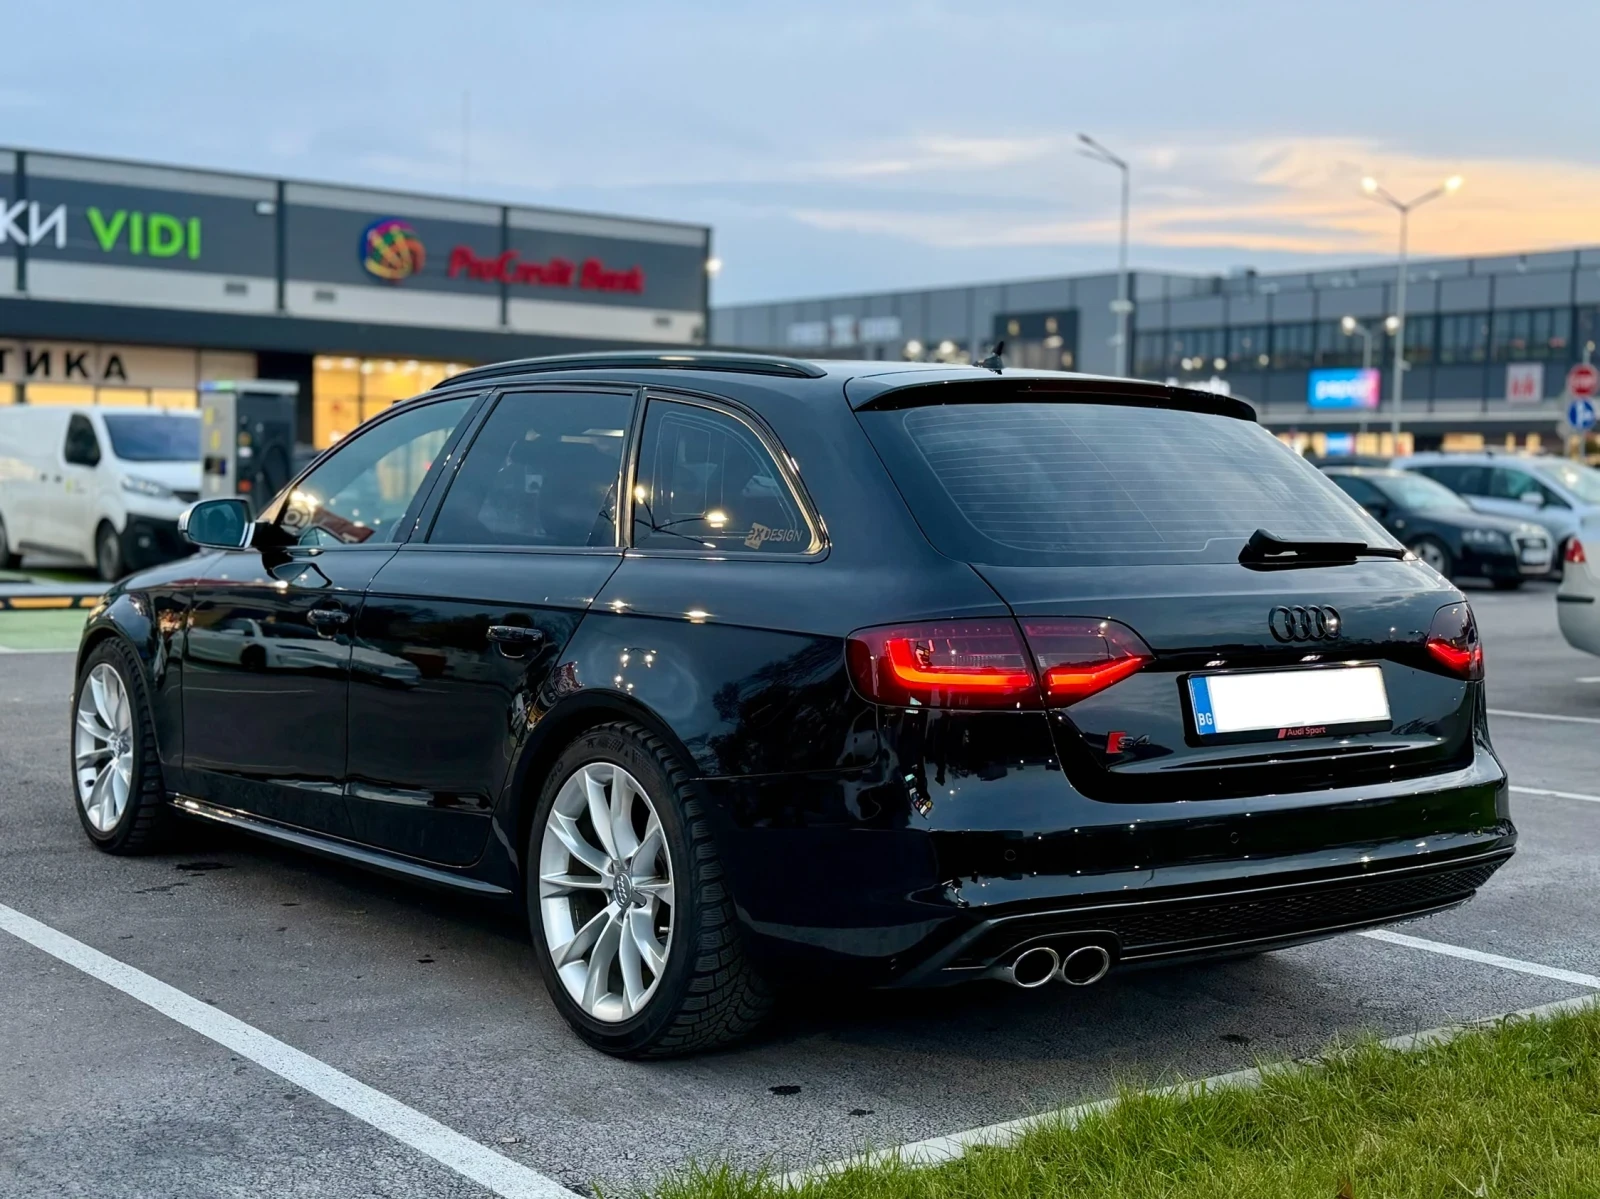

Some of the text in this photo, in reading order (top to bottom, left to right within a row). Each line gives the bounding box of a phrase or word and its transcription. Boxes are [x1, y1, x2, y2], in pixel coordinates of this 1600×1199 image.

[86, 206, 202, 260] VIDI
[579, 257, 645, 293] Bank
[1197, 712, 1213, 726] BG
[1287, 726, 1327, 737] Audi Sport
